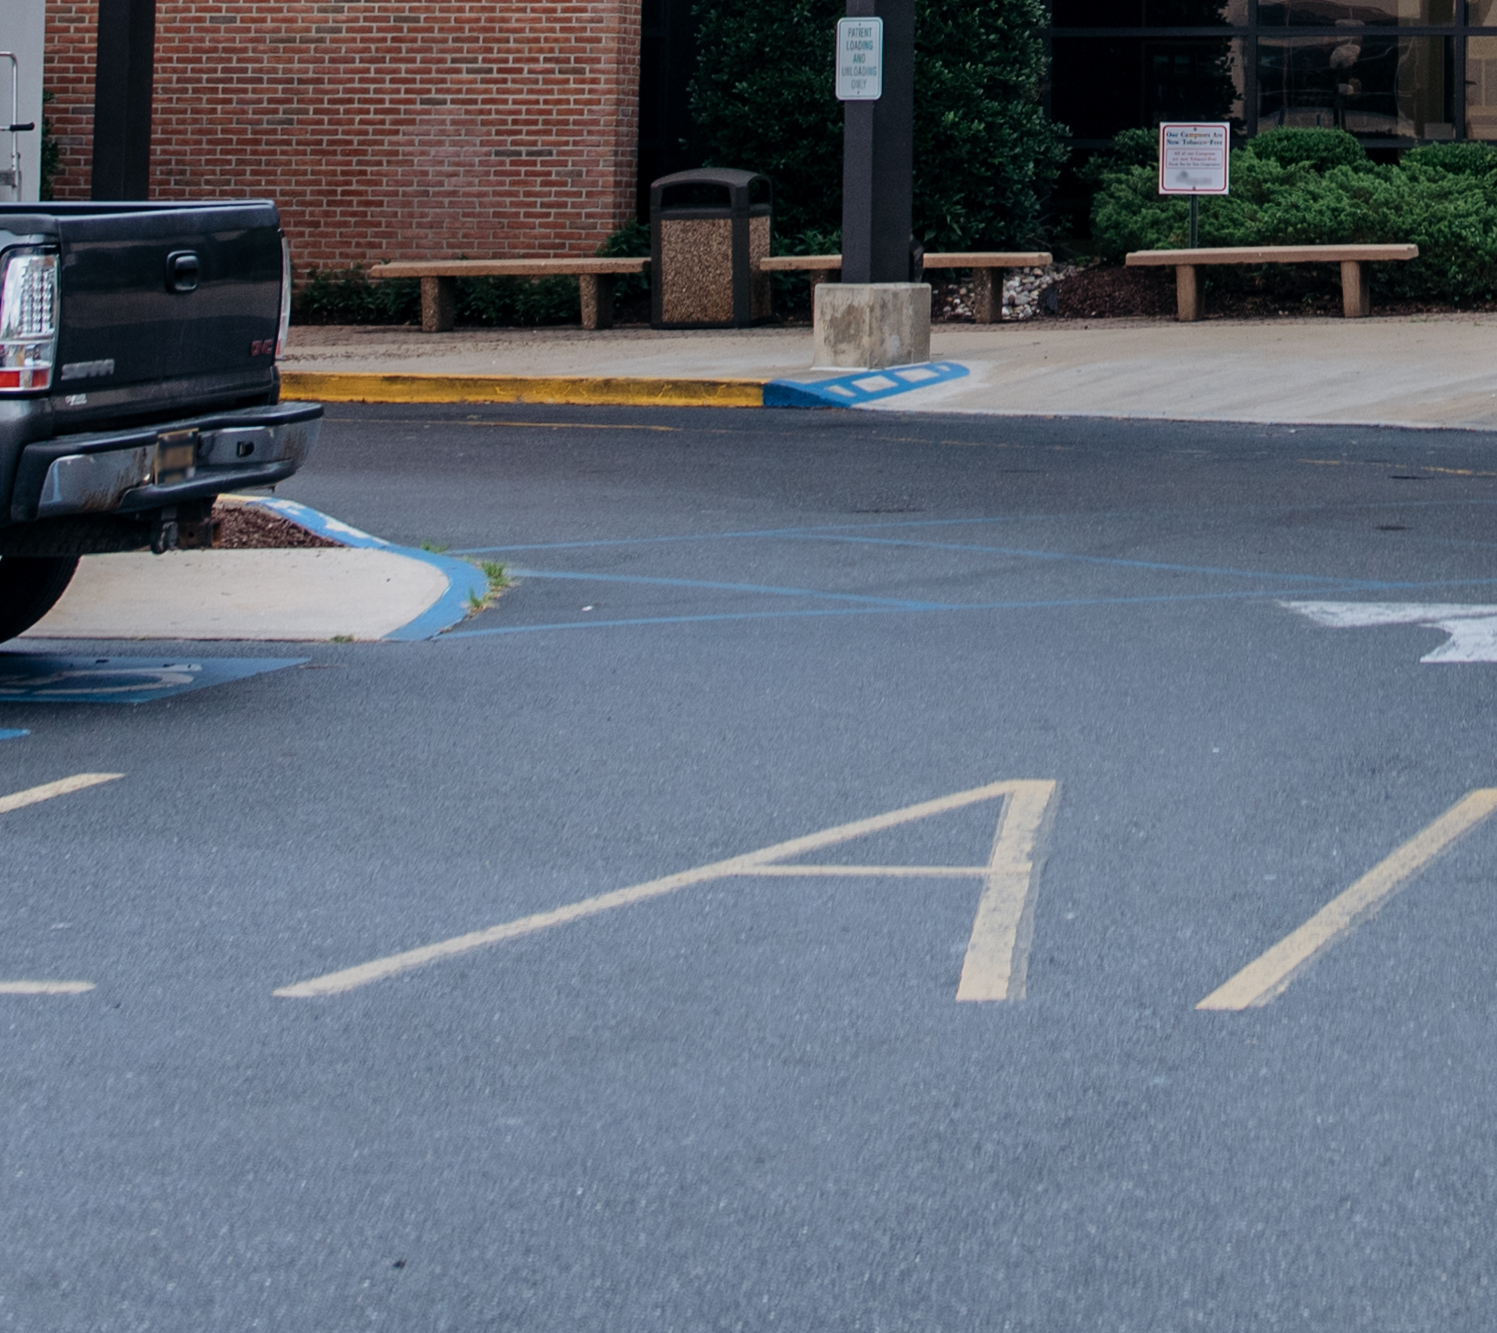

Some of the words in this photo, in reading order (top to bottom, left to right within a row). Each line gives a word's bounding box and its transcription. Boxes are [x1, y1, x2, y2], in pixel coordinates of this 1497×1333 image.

[848, 27, 872, 38] PATIENT
[846, 40, 873, 51] LOADING
[853, 53, 866, 64] AND
[842, 66, 877, 77] UNLOADING
[851, 79, 867, 90] ONLY
